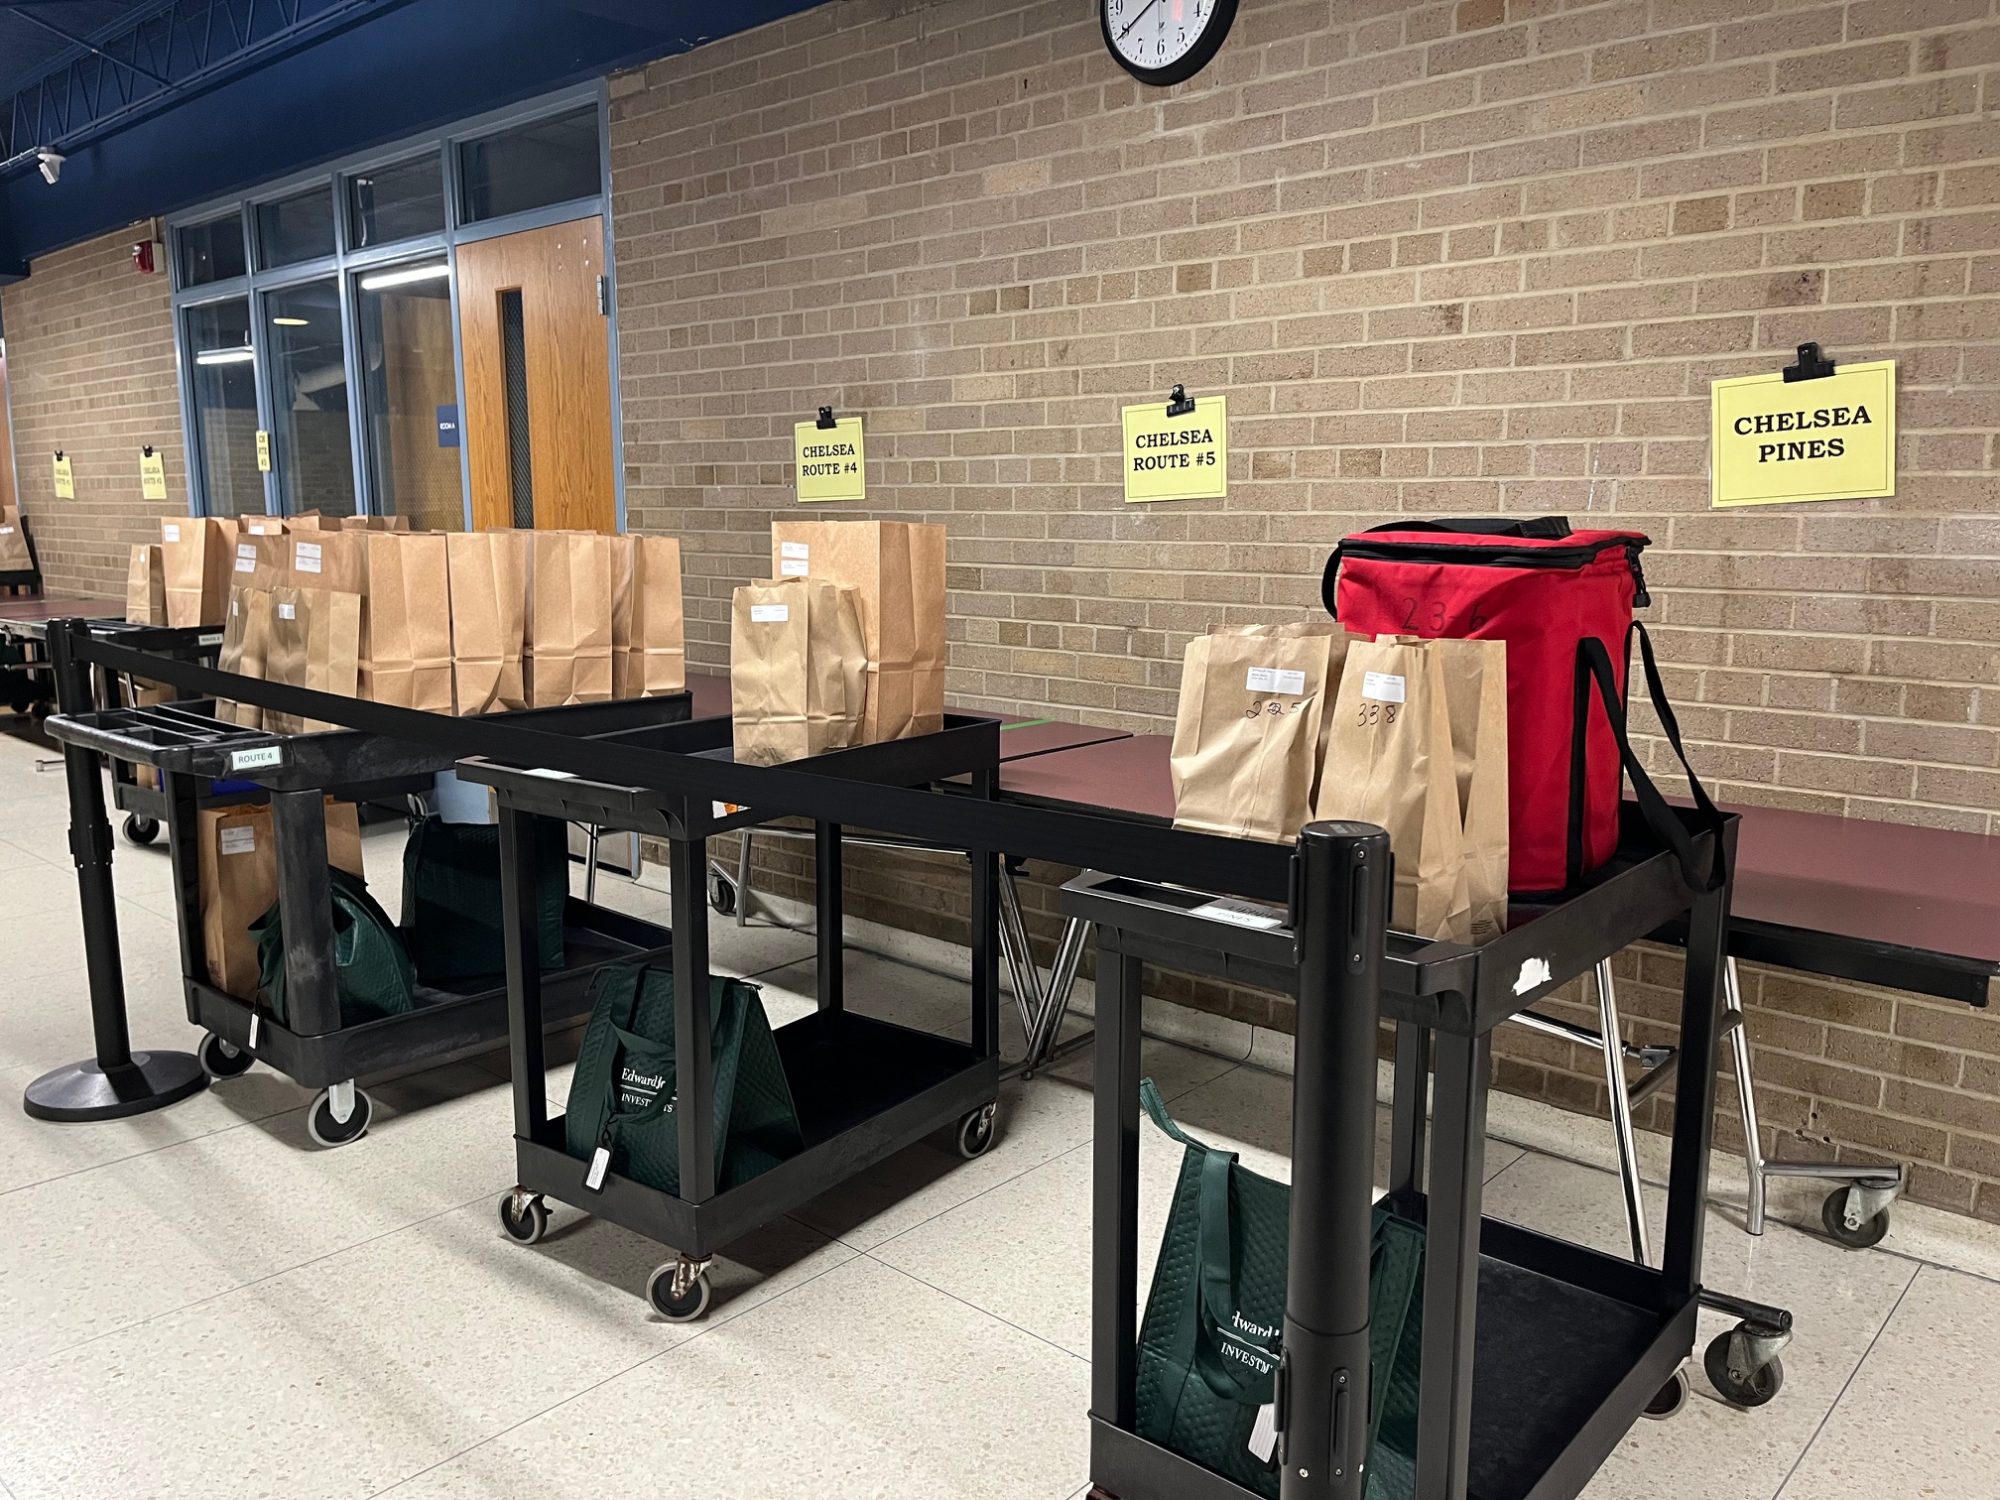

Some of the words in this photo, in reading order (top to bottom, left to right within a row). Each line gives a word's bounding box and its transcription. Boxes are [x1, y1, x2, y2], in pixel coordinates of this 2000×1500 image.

[1193, 1, 1201, 17] 4
[1176, 26, 1185, 43] 5
[1138, 38, 1144, 54] 7
[1157, 39, 1165, 55] 6
[1734, 405, 1872, 435] CHELSEA
[1135, 429, 1213, 449] CHELSEA
[802, 443, 855, 458] CHELSEA
[1758, 438, 1845, 463] PINES
[802, 463, 840, 476] ROUTE
[844, 462, 857, 474] #4
[1133, 454, 1190, 471] ROUTE
[1196, 451, 1216, 466] #5
[1358, 703, 1396, 727] 338
[238, 753, 265, 763] ROUTE
